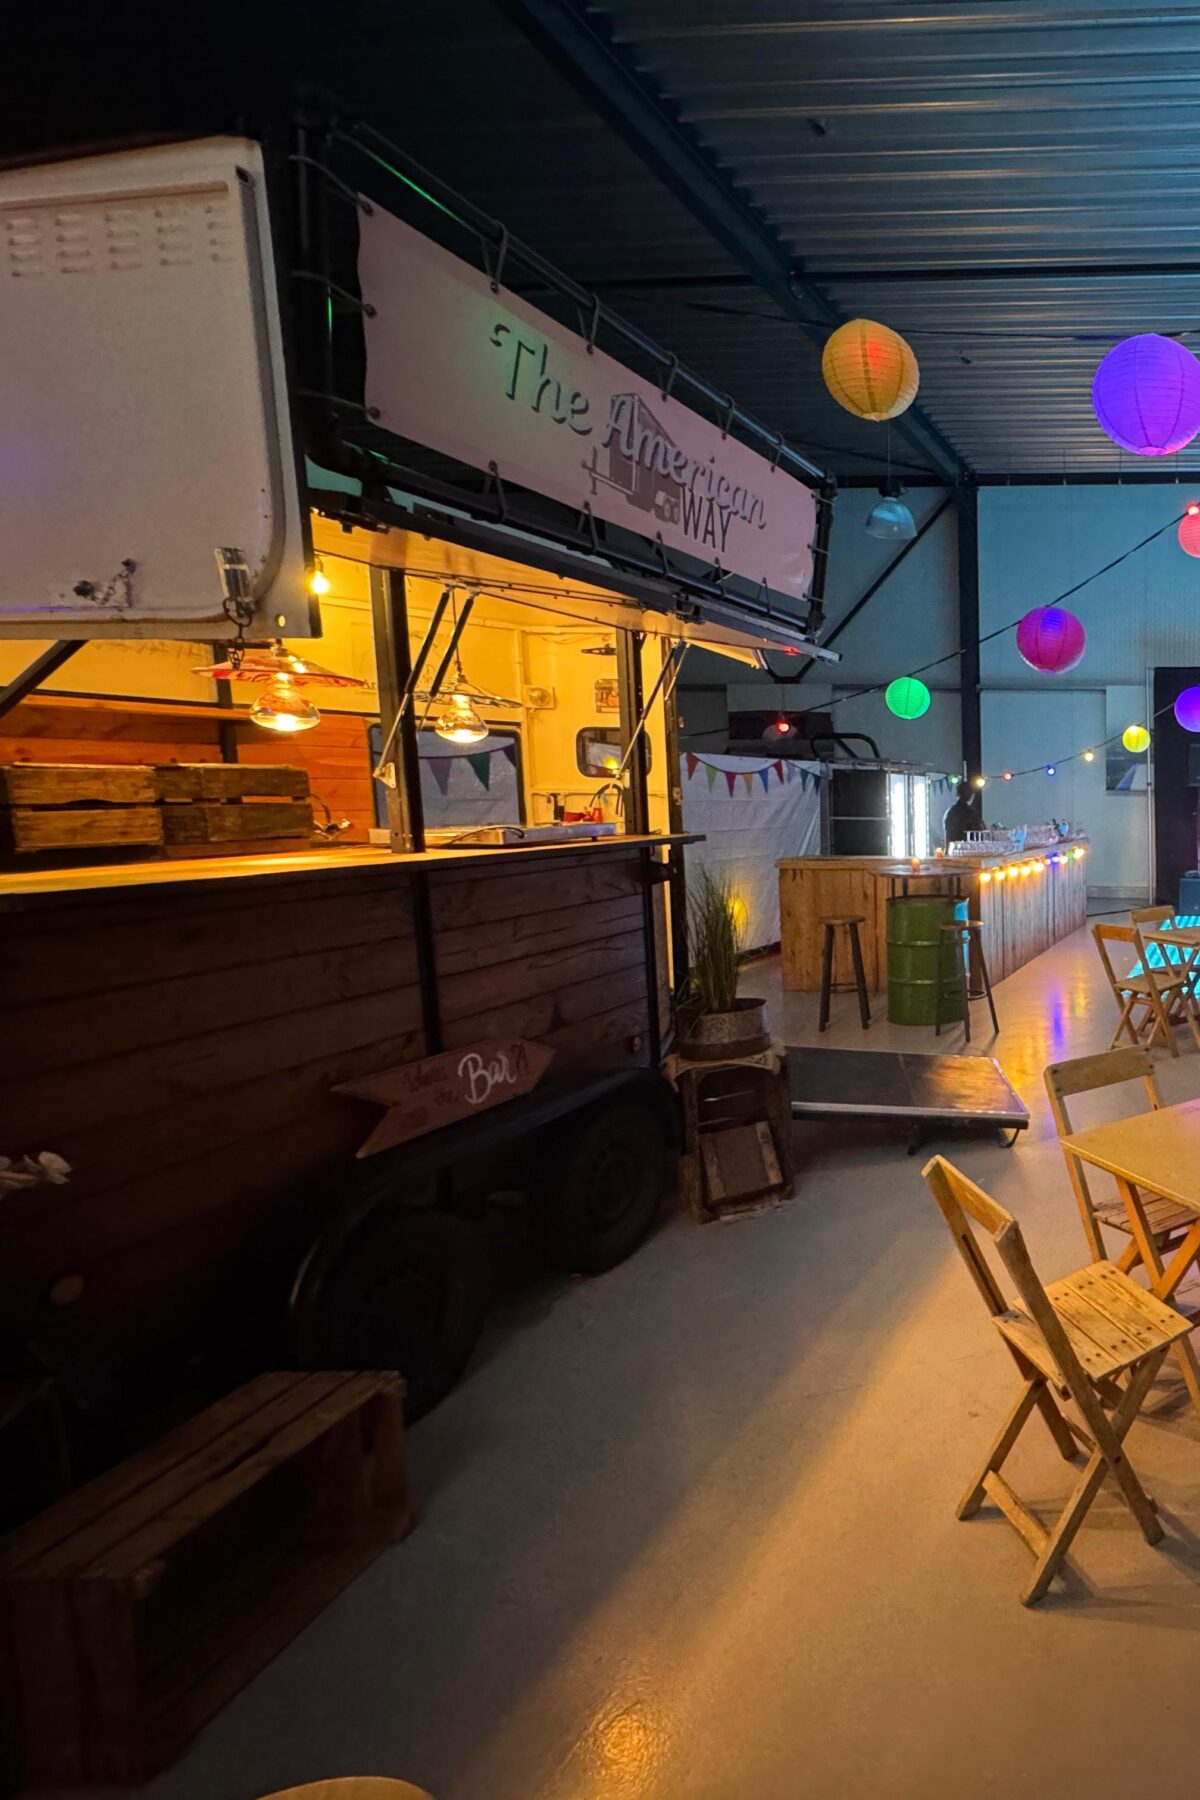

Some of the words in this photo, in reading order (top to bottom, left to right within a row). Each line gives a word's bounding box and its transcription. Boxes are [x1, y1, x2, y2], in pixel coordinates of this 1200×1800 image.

[489, 323, 593, 436] The
[602, 399, 767, 529] American
[682, 485, 732, 553] WAY
[457, 1052, 517, 1105] Bar
